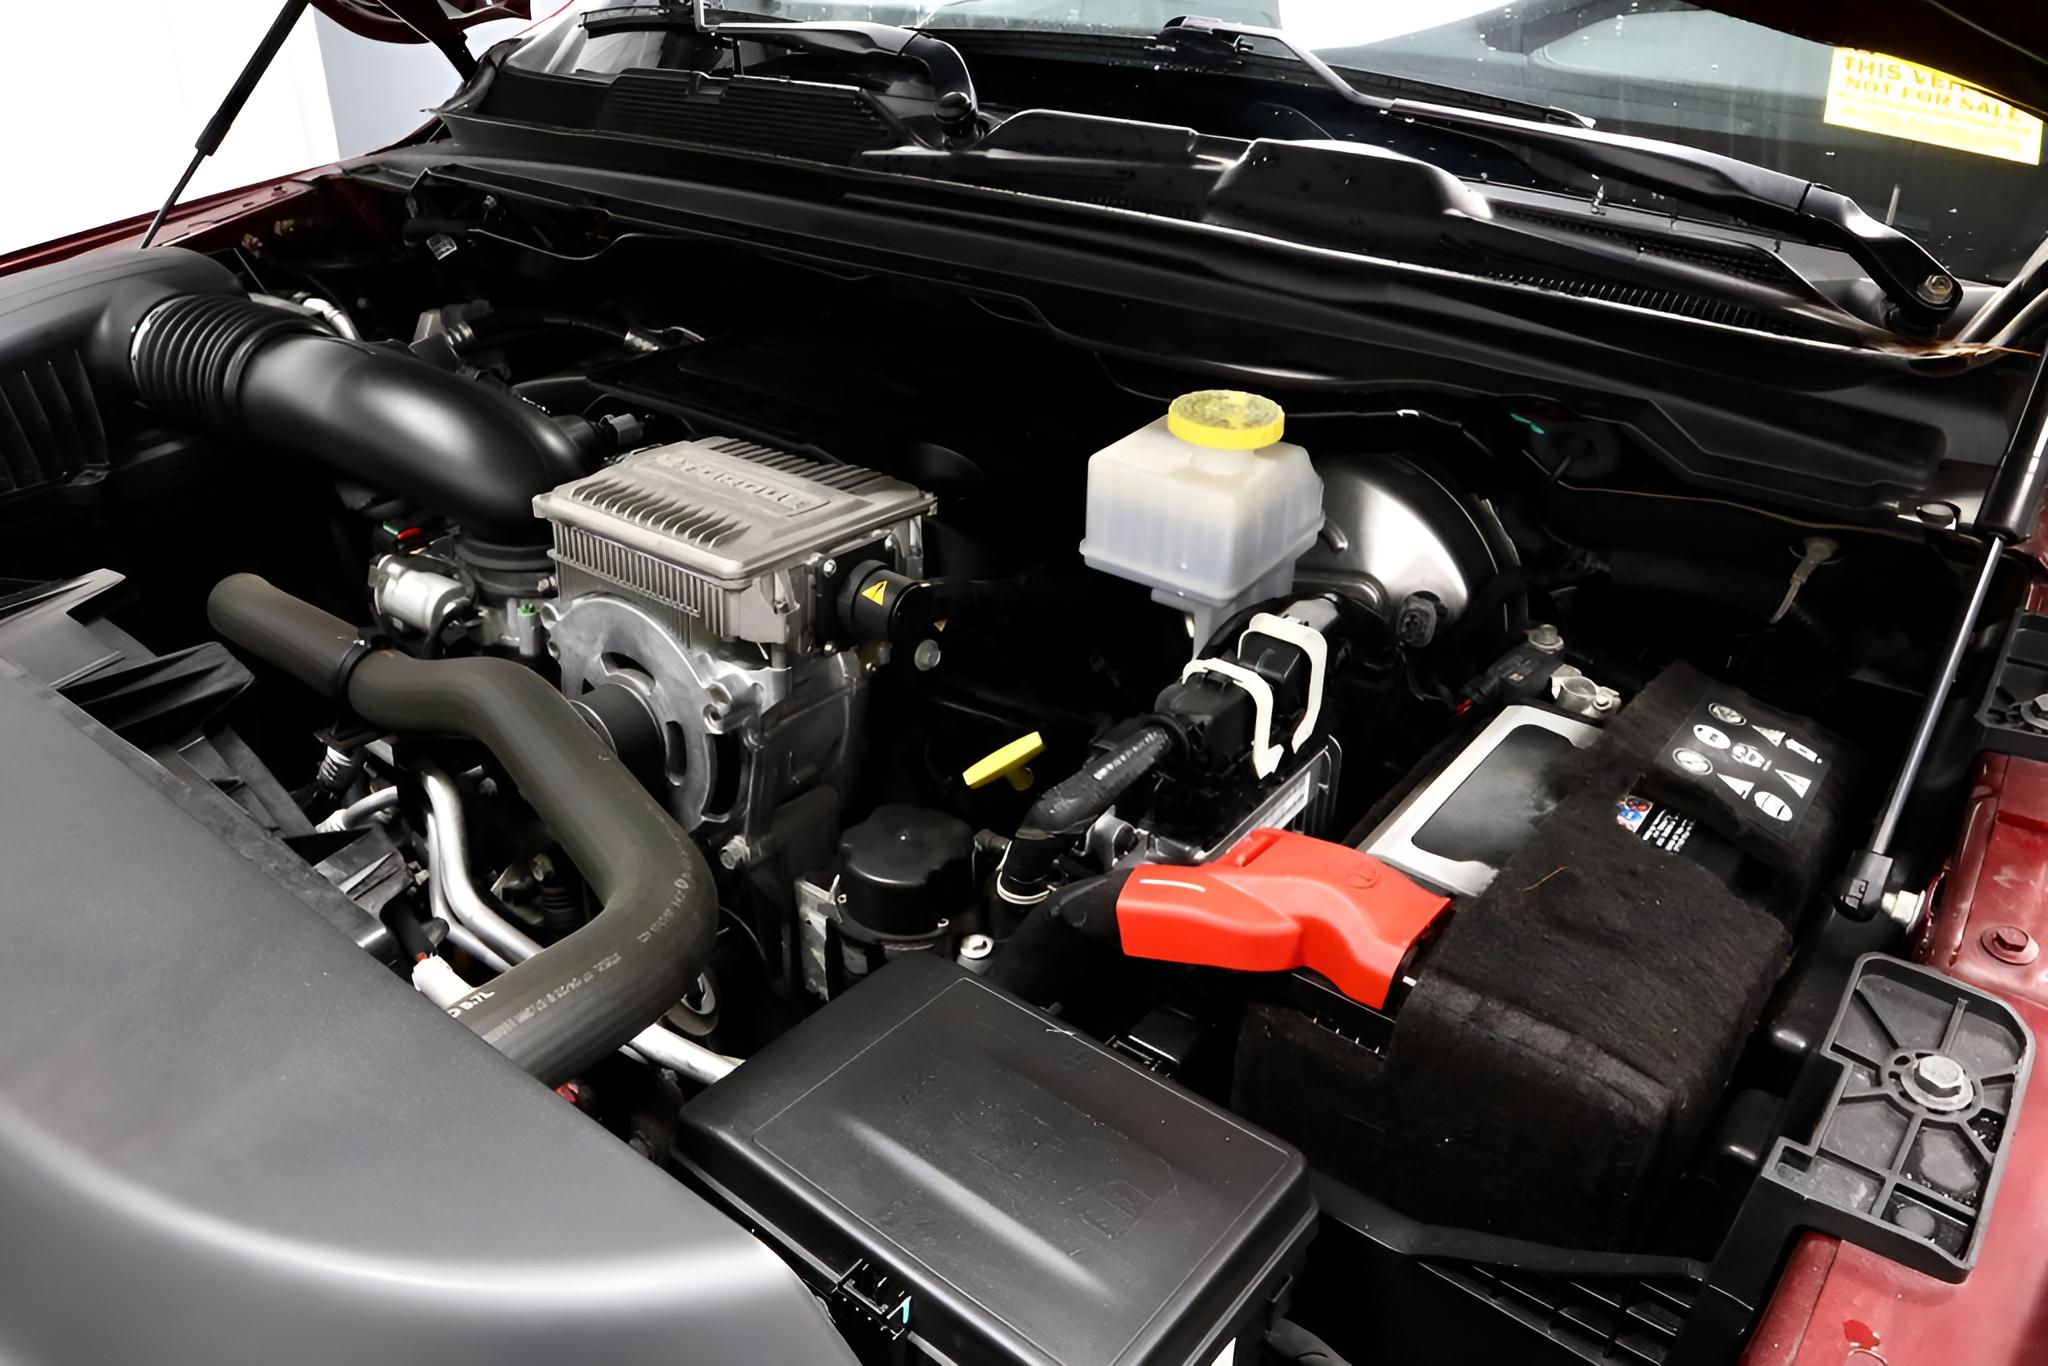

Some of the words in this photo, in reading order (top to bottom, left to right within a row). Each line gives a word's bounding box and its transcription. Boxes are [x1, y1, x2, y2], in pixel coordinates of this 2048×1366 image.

[1843, 56, 1901, 80] THIS
[1843, 76, 1892, 96] NOT
[1902, 84, 1951, 107] FOR
[1959, 98, 2022, 121] SALE
